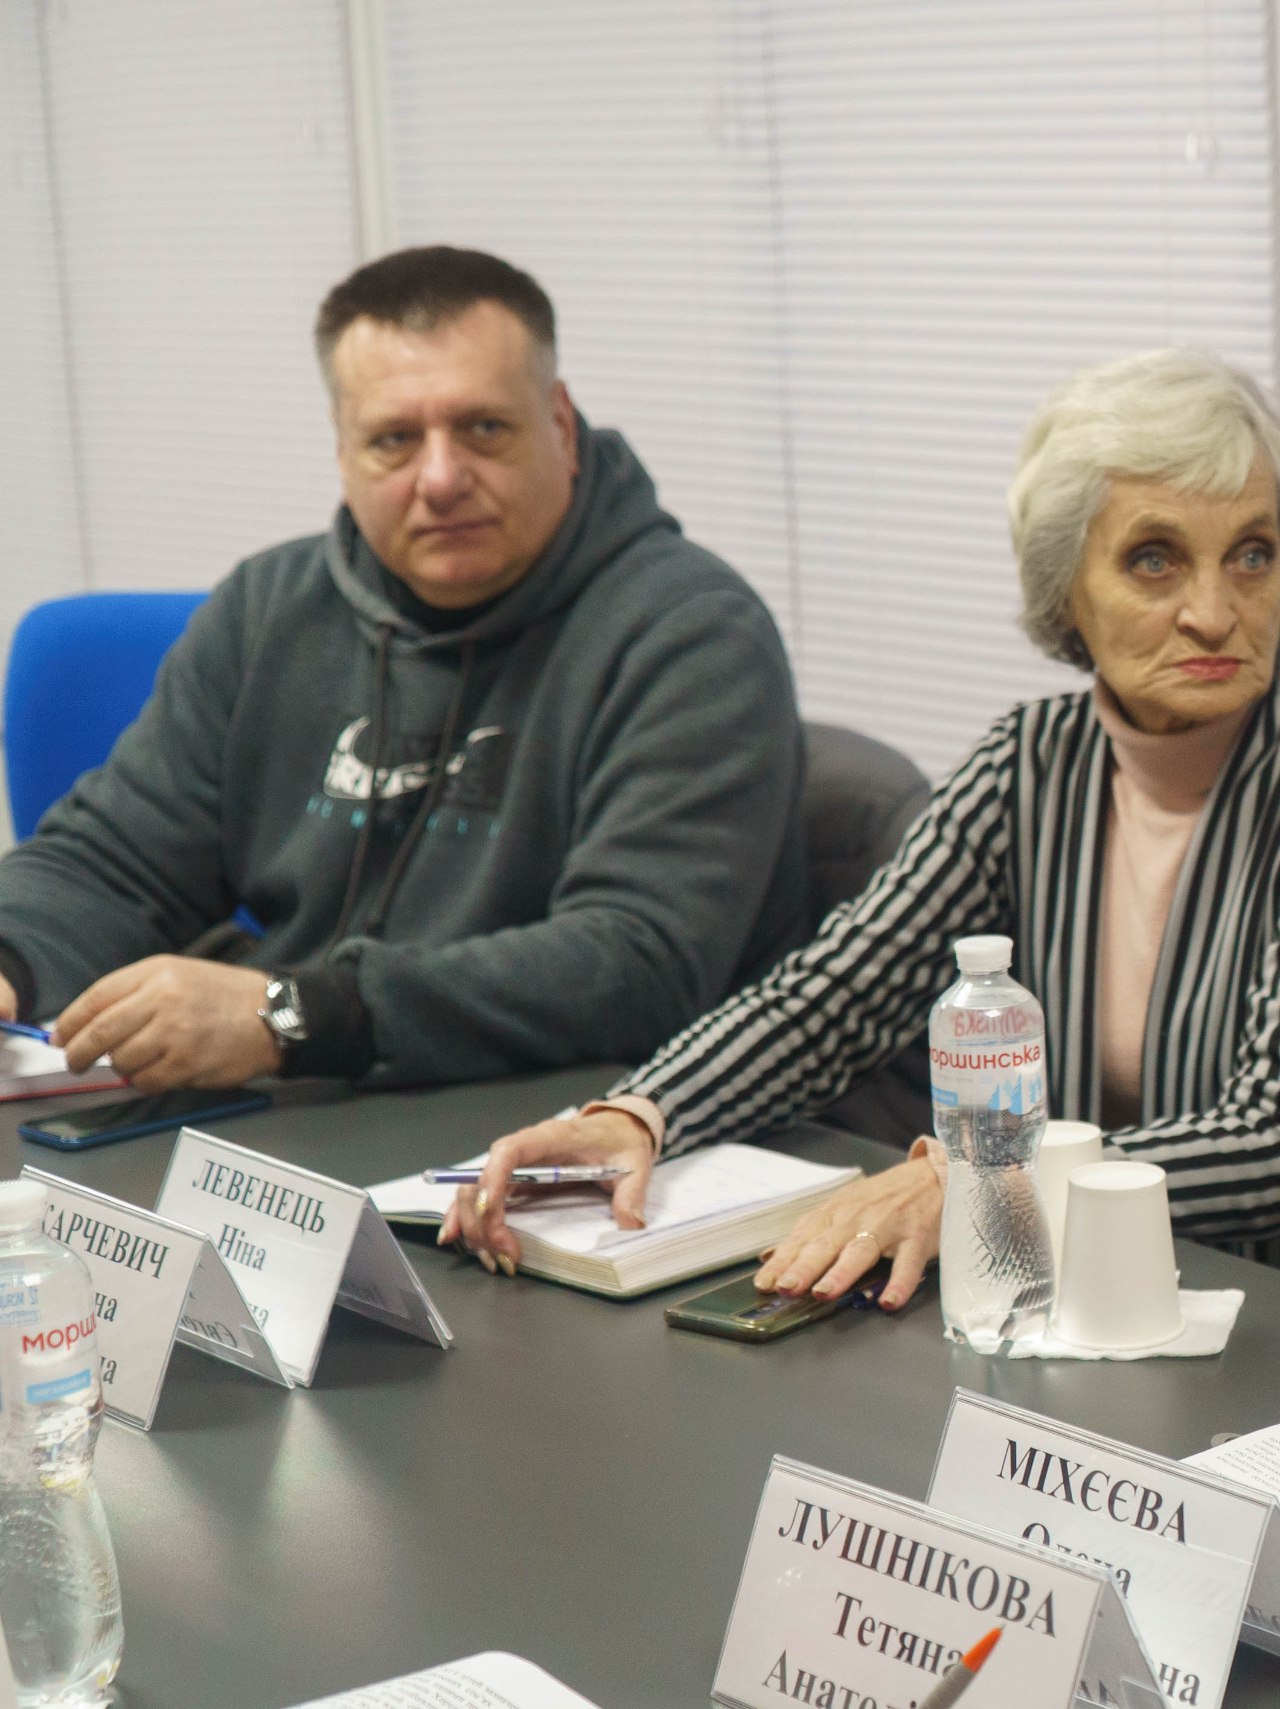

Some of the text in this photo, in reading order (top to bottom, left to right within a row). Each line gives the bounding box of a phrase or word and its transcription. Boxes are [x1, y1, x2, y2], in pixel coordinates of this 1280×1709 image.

[930, 1045, 1039, 1070] оршинська
[192, 1159, 325, 1236] ЛЕВЕНЕЦЬ
[218, 1224, 266, 1271] Ніна
[997, 1438, 1188, 1545] МІХЄЄВА
[778, 1498, 1057, 1638] ЛУШНІКОВА
[762, 1648, 917, 1709] Анато
